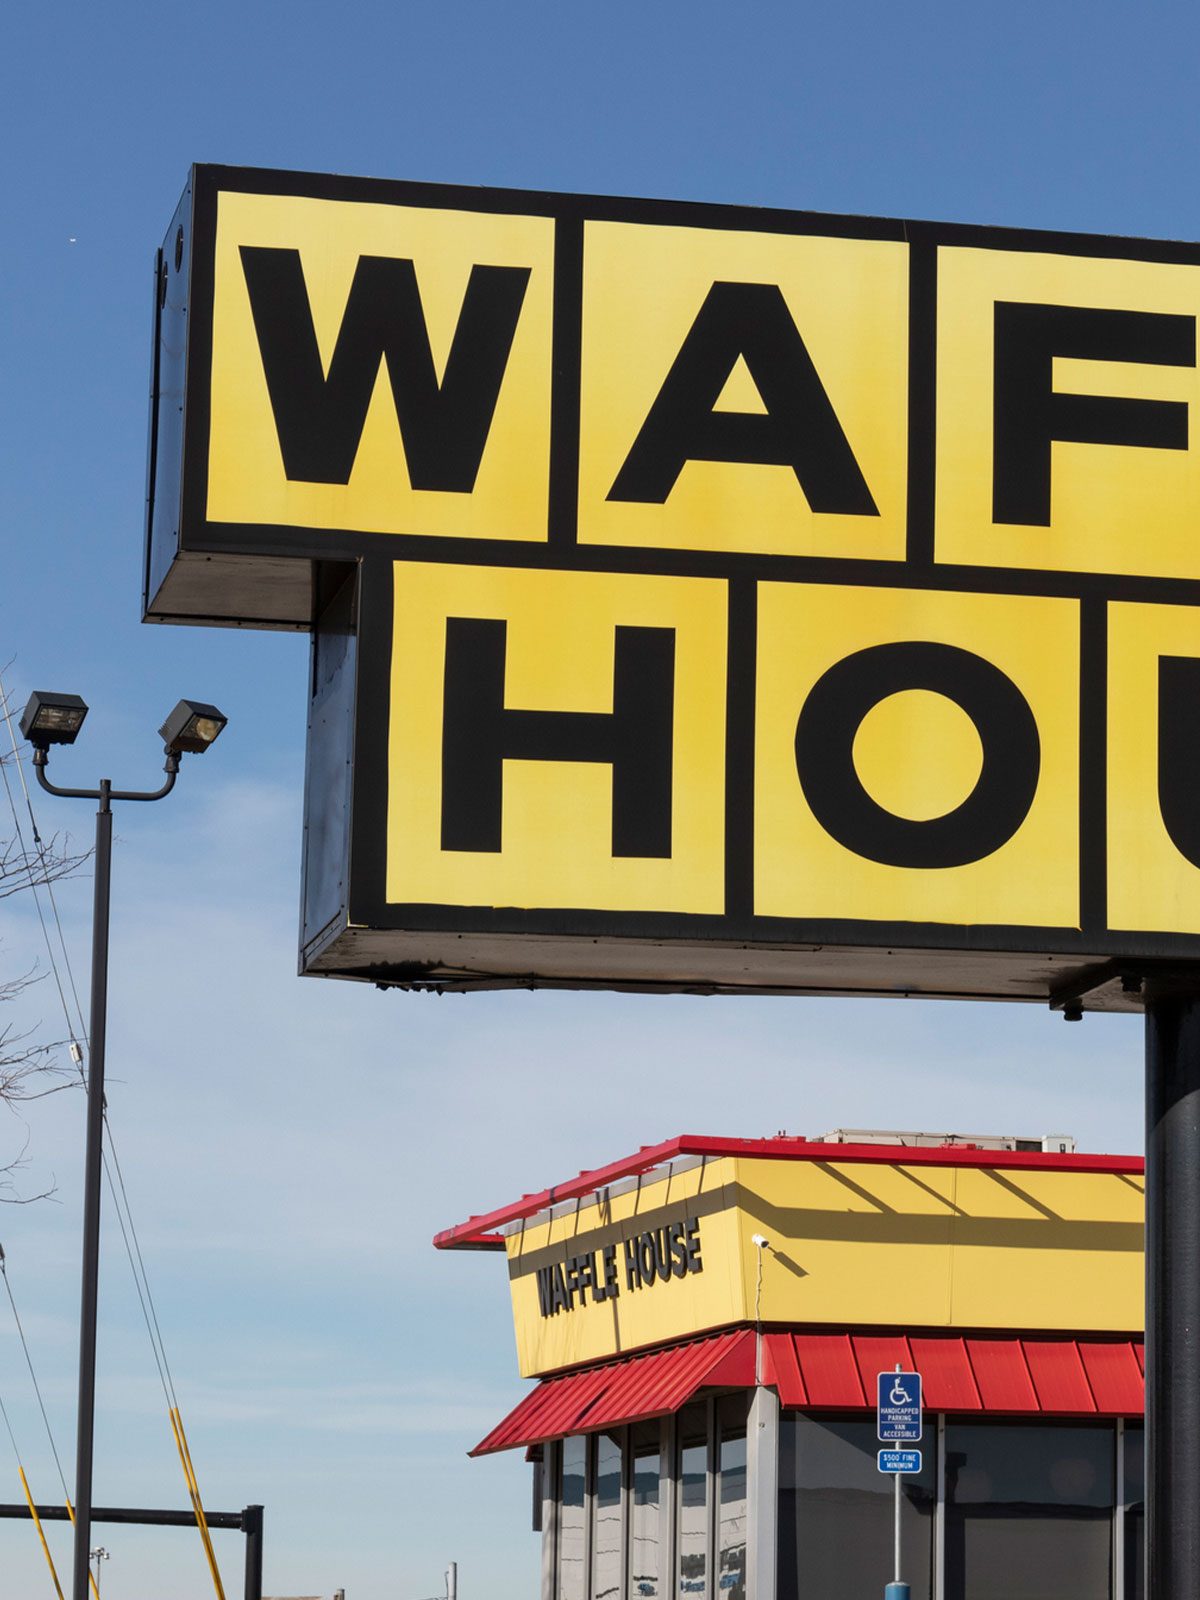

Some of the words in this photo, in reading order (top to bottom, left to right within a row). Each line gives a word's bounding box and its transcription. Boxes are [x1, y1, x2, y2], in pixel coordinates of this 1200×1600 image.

[536, 1243, 620, 1319] WAFFLE
[624, 1215, 703, 1292] HOUSE
[880, 1407, 919, 1415] HANDICAPPED
[883, 1430, 917, 1438] ACCESSIBLE
[902, 1454, 916, 1462] FINE
